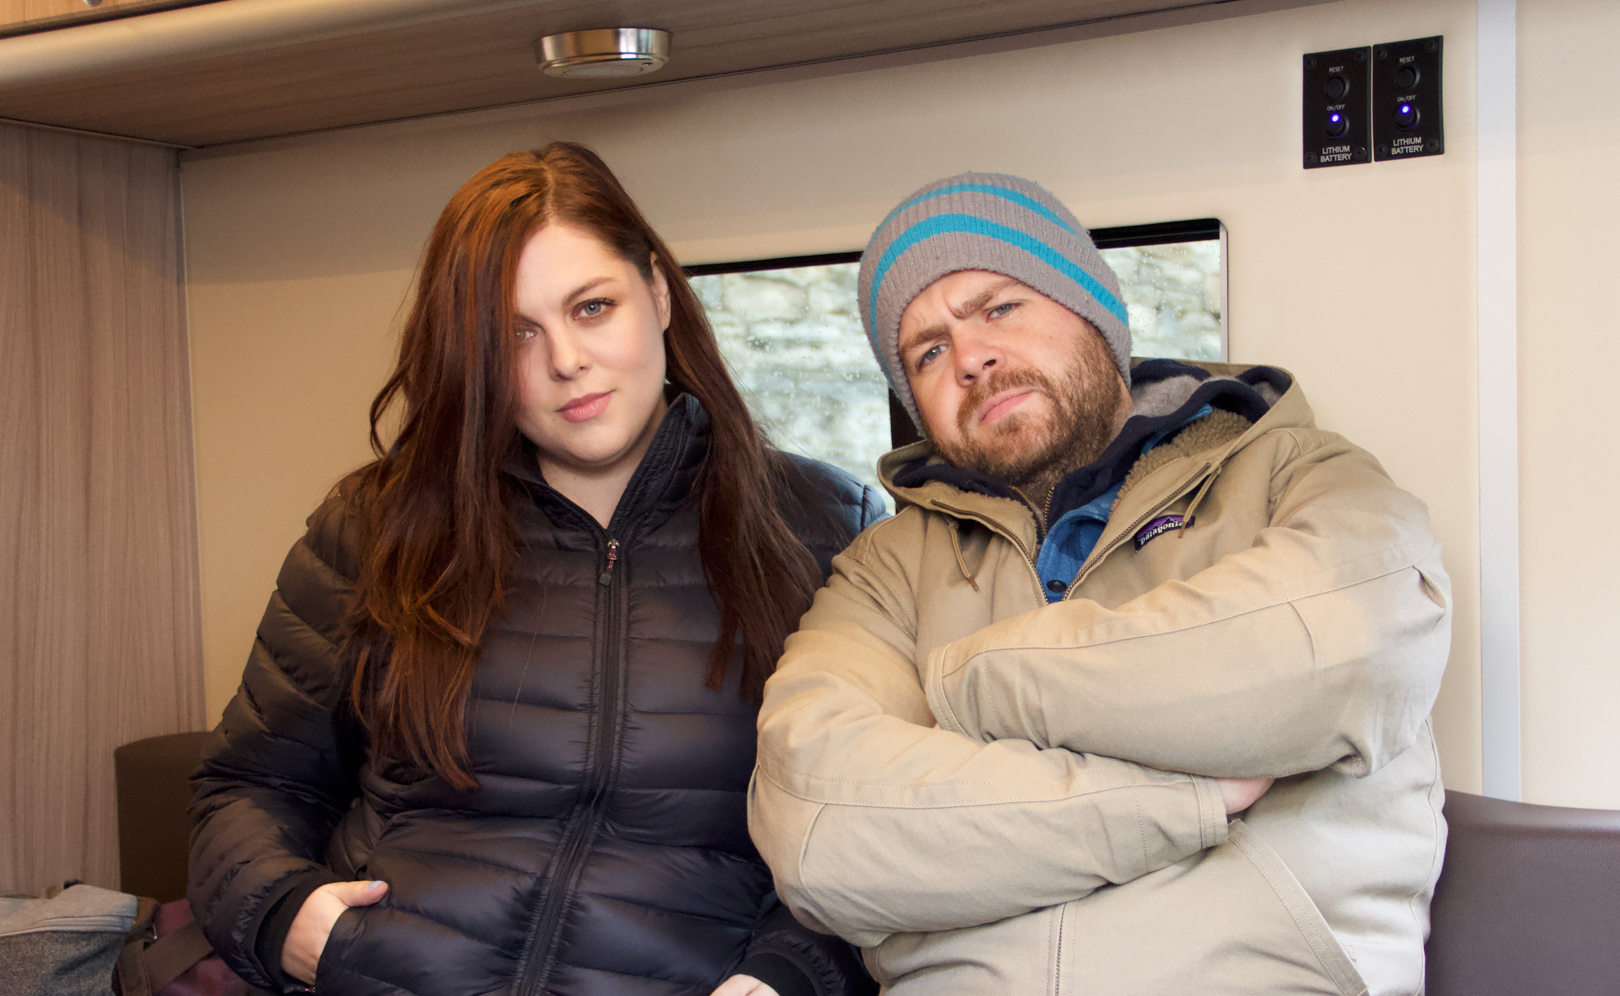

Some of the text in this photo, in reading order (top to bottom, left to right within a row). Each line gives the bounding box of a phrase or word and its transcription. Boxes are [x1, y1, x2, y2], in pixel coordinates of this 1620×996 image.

[1393, 137, 1422, 147] LITHIUM
[1322, 145, 1350, 155] LITHIUM
[1391, 144, 1424, 155] BATTERY
[1320, 153, 1352, 163] BATTERY
